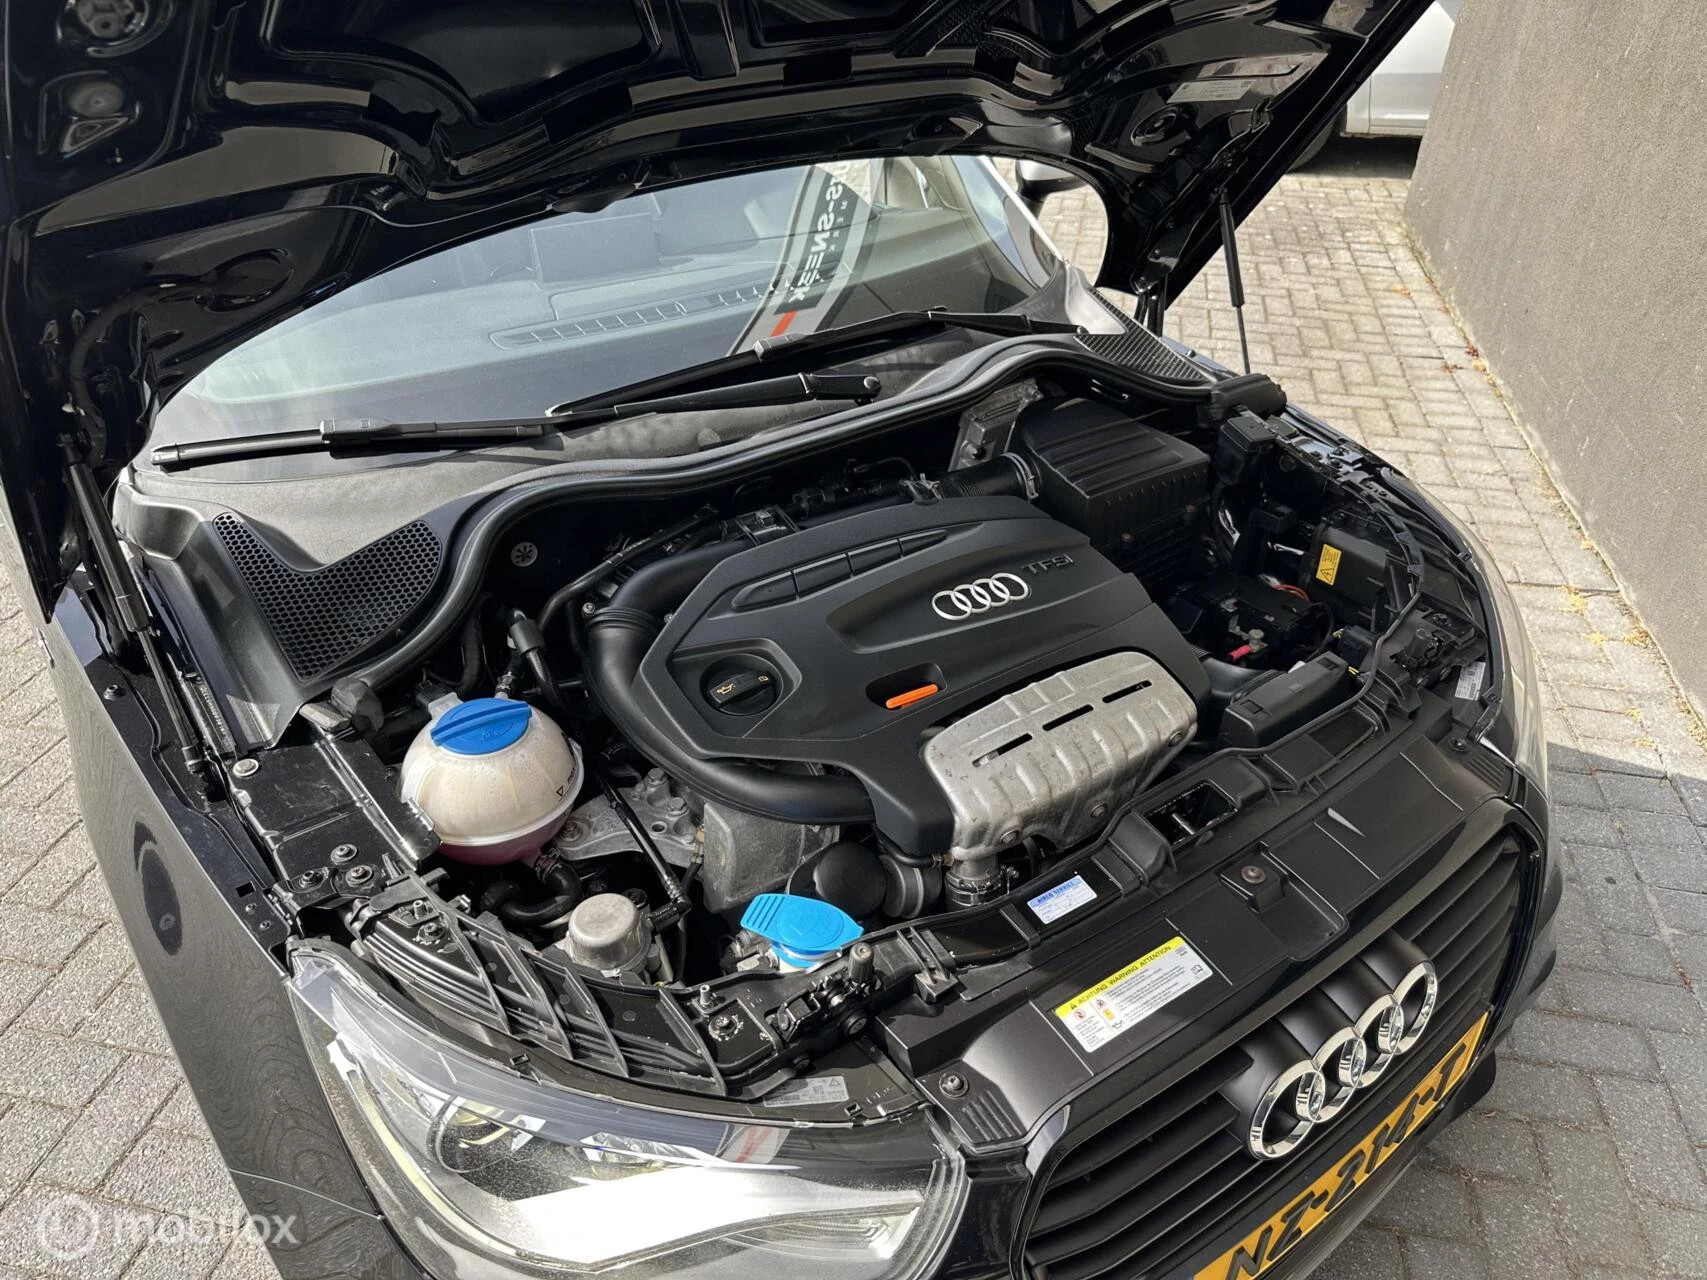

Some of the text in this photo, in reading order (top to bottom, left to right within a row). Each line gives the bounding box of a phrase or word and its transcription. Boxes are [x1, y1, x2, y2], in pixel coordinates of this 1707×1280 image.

[1022, 554, 1074, 574] TFSI
[1078, 945, 1172, 1003] ACHTUNG WARNING ATTENTION
